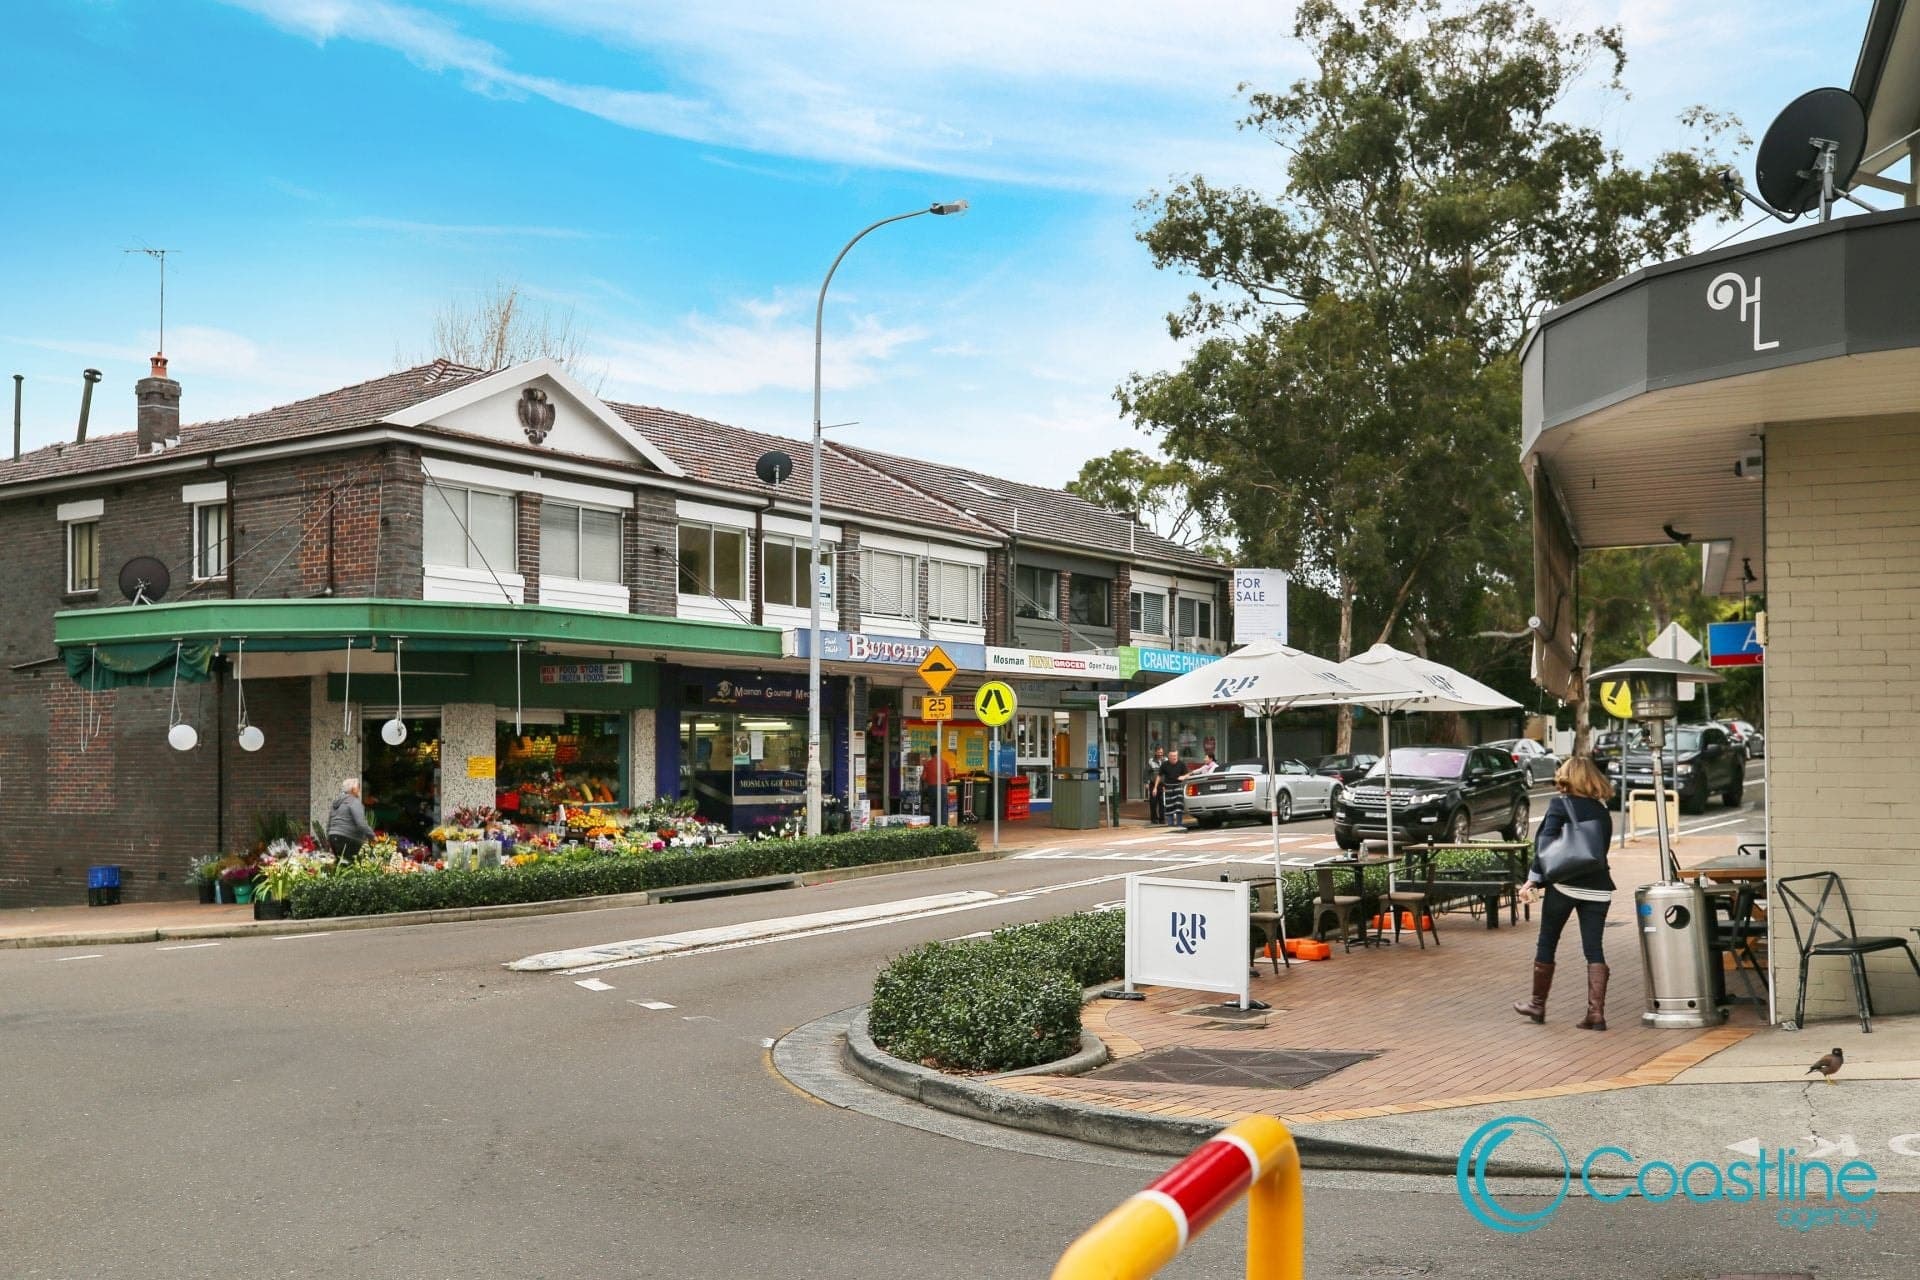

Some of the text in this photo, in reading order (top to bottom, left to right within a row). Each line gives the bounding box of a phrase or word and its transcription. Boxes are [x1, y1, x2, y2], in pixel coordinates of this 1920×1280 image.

[1236, 578, 1260, 588] FOR
[1236, 591, 1265, 602] SALE
[993, 654, 1025, 666] Mosman
[1054, 659, 1086, 670] GROCER
[1088, 661, 1102, 671] Open
[1143, 651, 1182, 671] CRANES
[579, 664, 604, 674] STORE
[735, 686, 762, 697] Mosman
[765, 688, 792, 698] Gourmet
[928, 698, 947, 712] 25
[740, 779, 769, 788] MOSMAN
